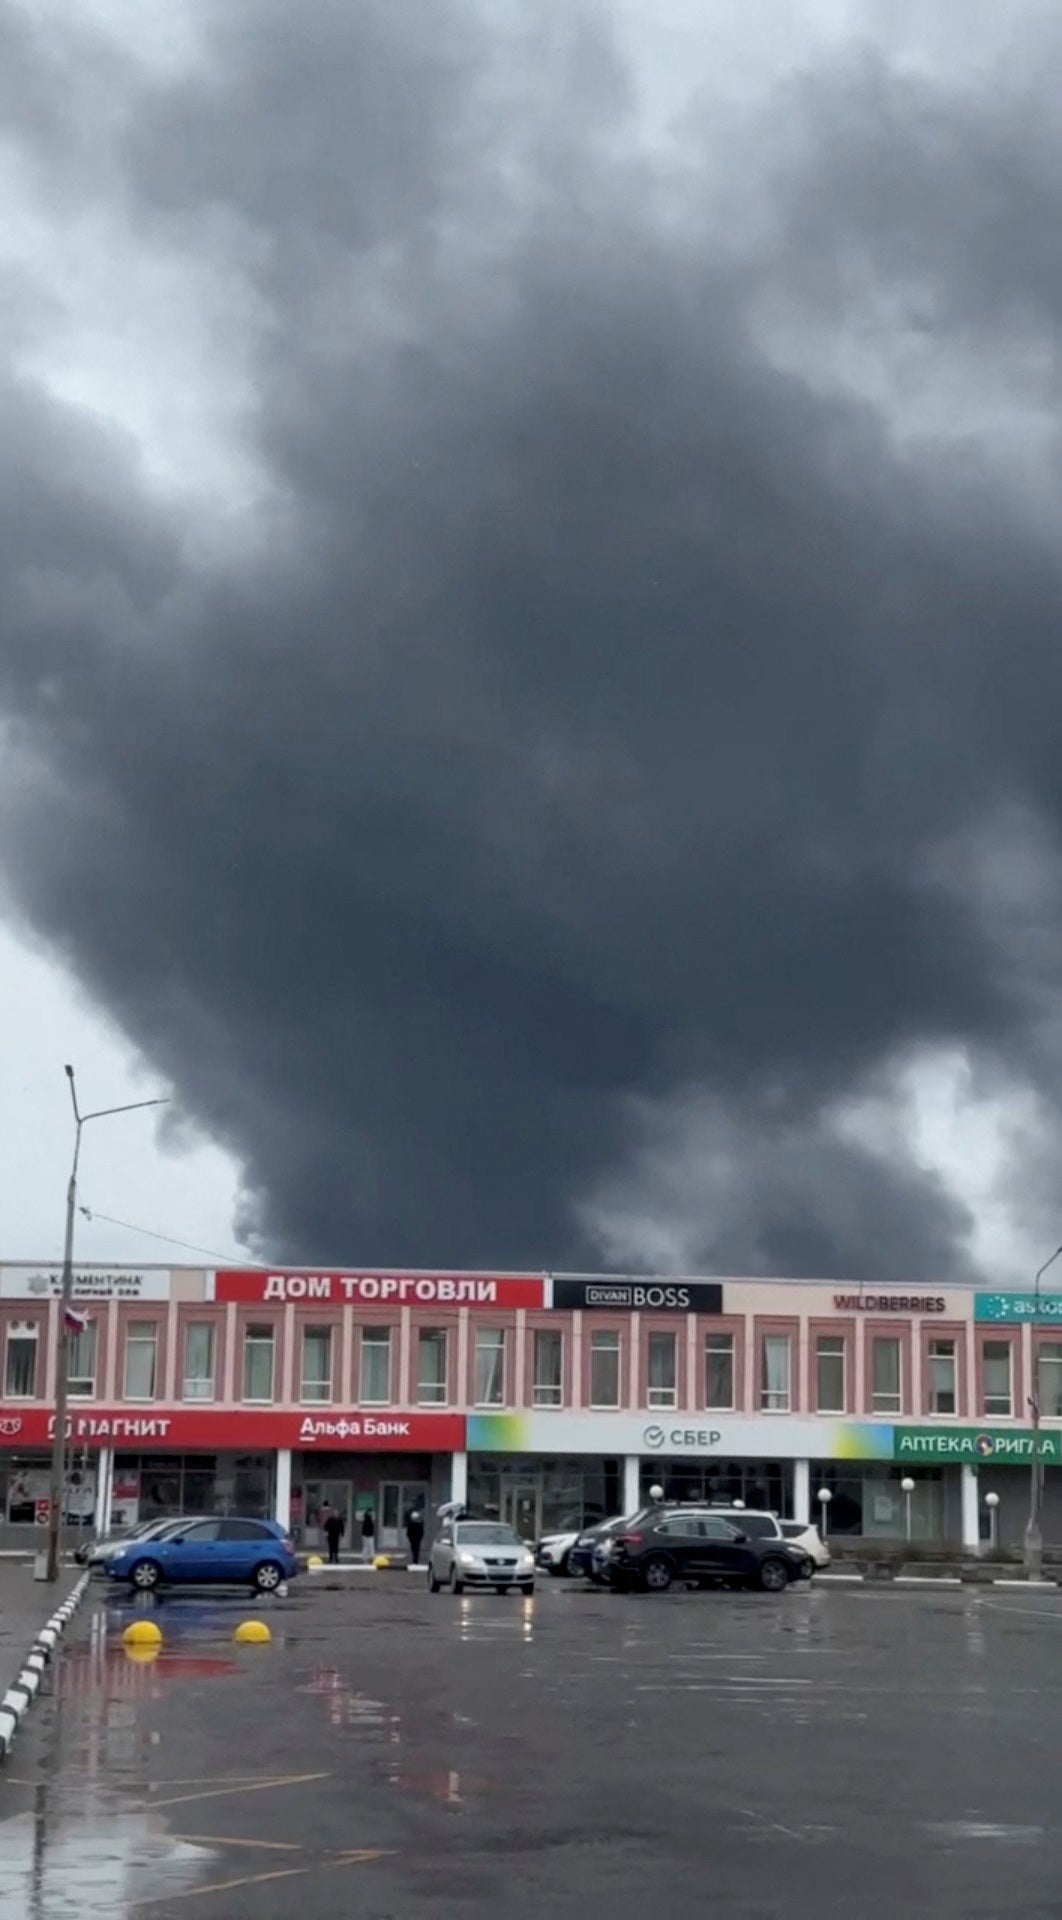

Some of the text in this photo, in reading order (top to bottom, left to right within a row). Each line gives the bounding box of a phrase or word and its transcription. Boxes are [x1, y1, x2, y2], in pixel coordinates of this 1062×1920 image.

[50, 1274, 142, 1286] КМЕНТИНА
[264, 1277, 497, 1302] ДОМ ТОРГОВЛИ
[589, 1287, 690, 1307] DIVAN BOSS
[833, 1295, 946, 1312] WILDBERRIES
[77, 1419, 171, 1436] МАГНИТ
[300, 1417, 410, 1440] Альфа Банк
[669, 1429, 721, 1446] СБЕР
[899, 1436, 973, 1453] АПТЕКА
